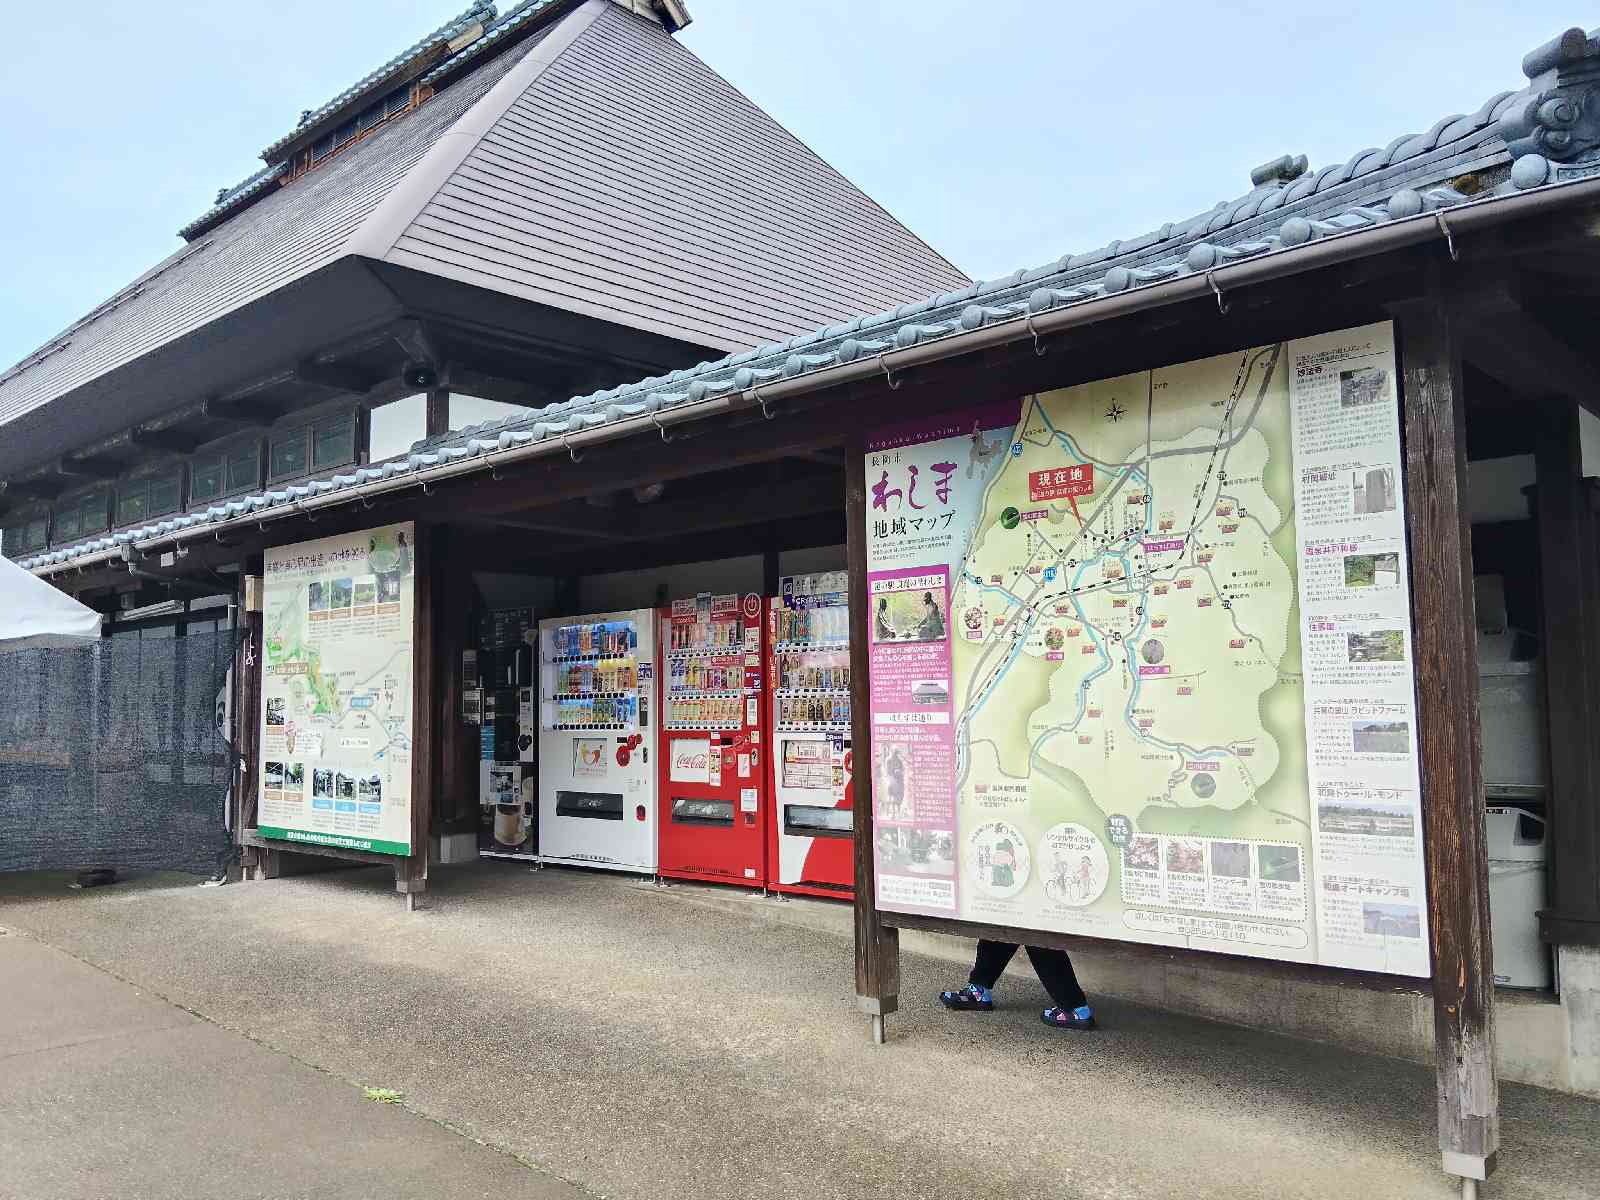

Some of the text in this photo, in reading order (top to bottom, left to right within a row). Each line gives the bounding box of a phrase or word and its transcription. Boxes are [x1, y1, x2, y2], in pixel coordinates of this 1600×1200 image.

[871, 461, 958, 512] わしま
[1038, 467, 1083, 487] 現在地
[873, 509, 957, 538] 地域マップ
